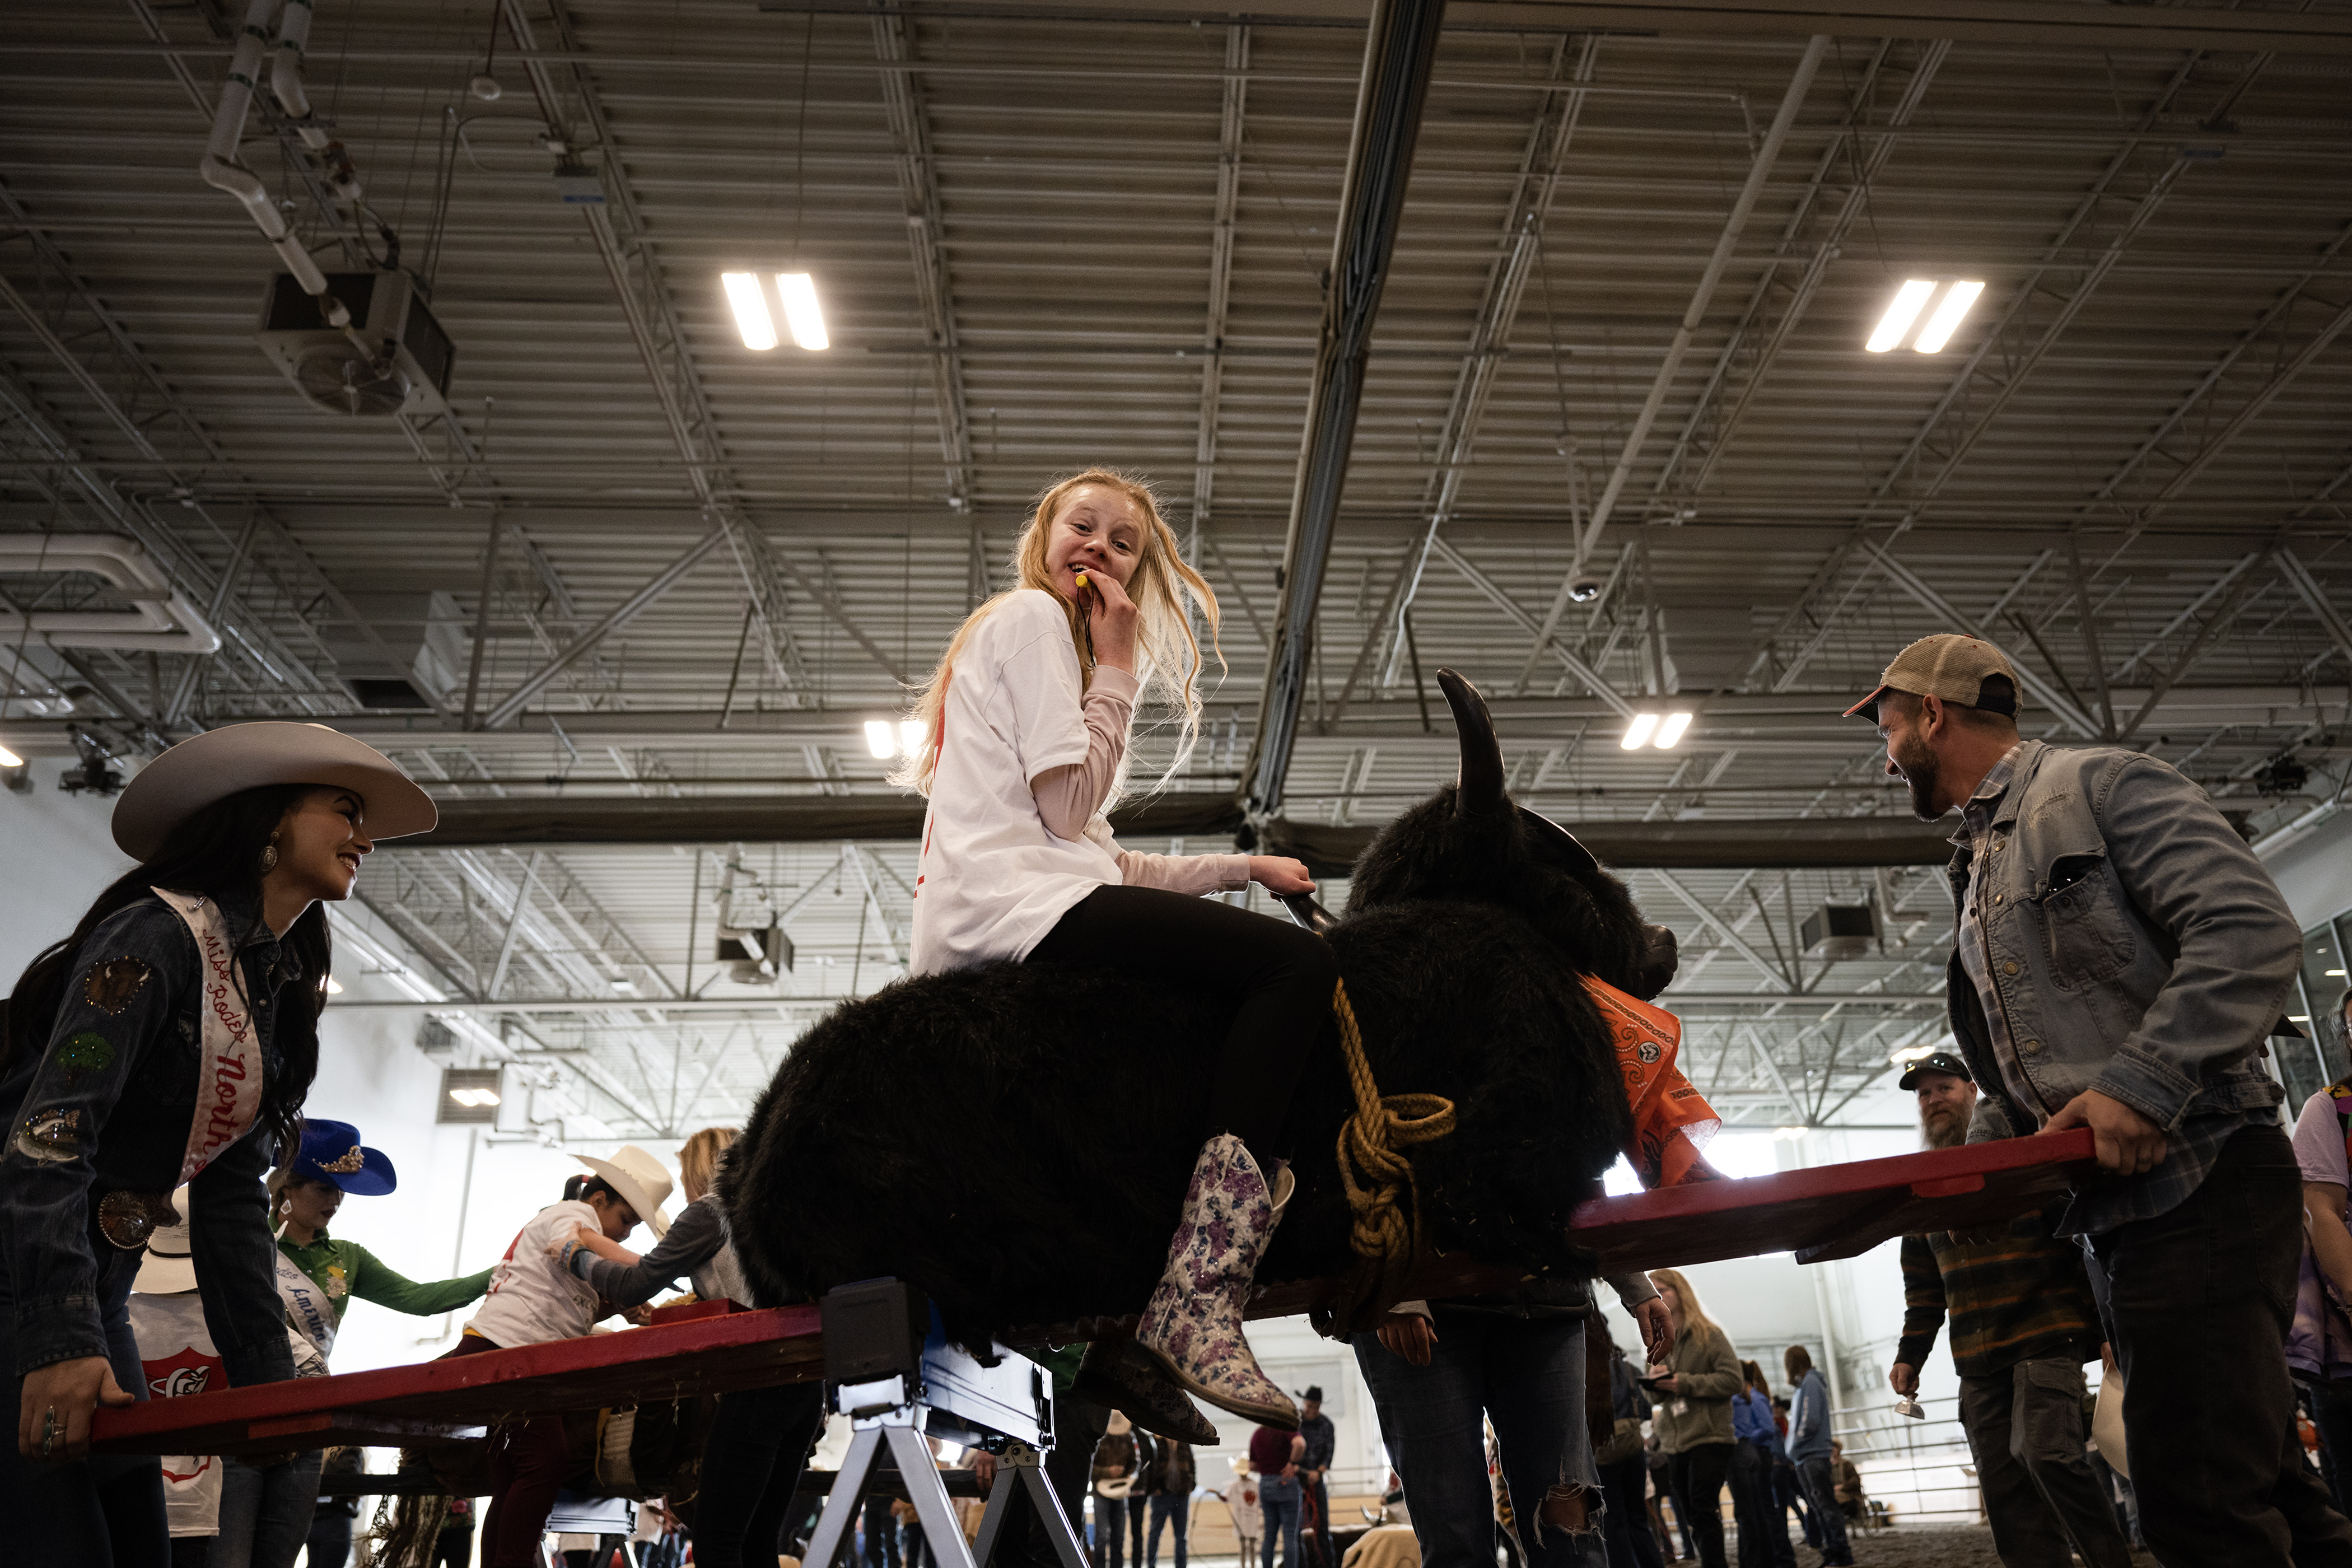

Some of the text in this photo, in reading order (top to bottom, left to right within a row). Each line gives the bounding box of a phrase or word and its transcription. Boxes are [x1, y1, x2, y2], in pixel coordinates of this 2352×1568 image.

[203, 929, 231, 981] Miss
[203, 1053, 246, 1154] North
[285, 1285, 325, 1343] America
